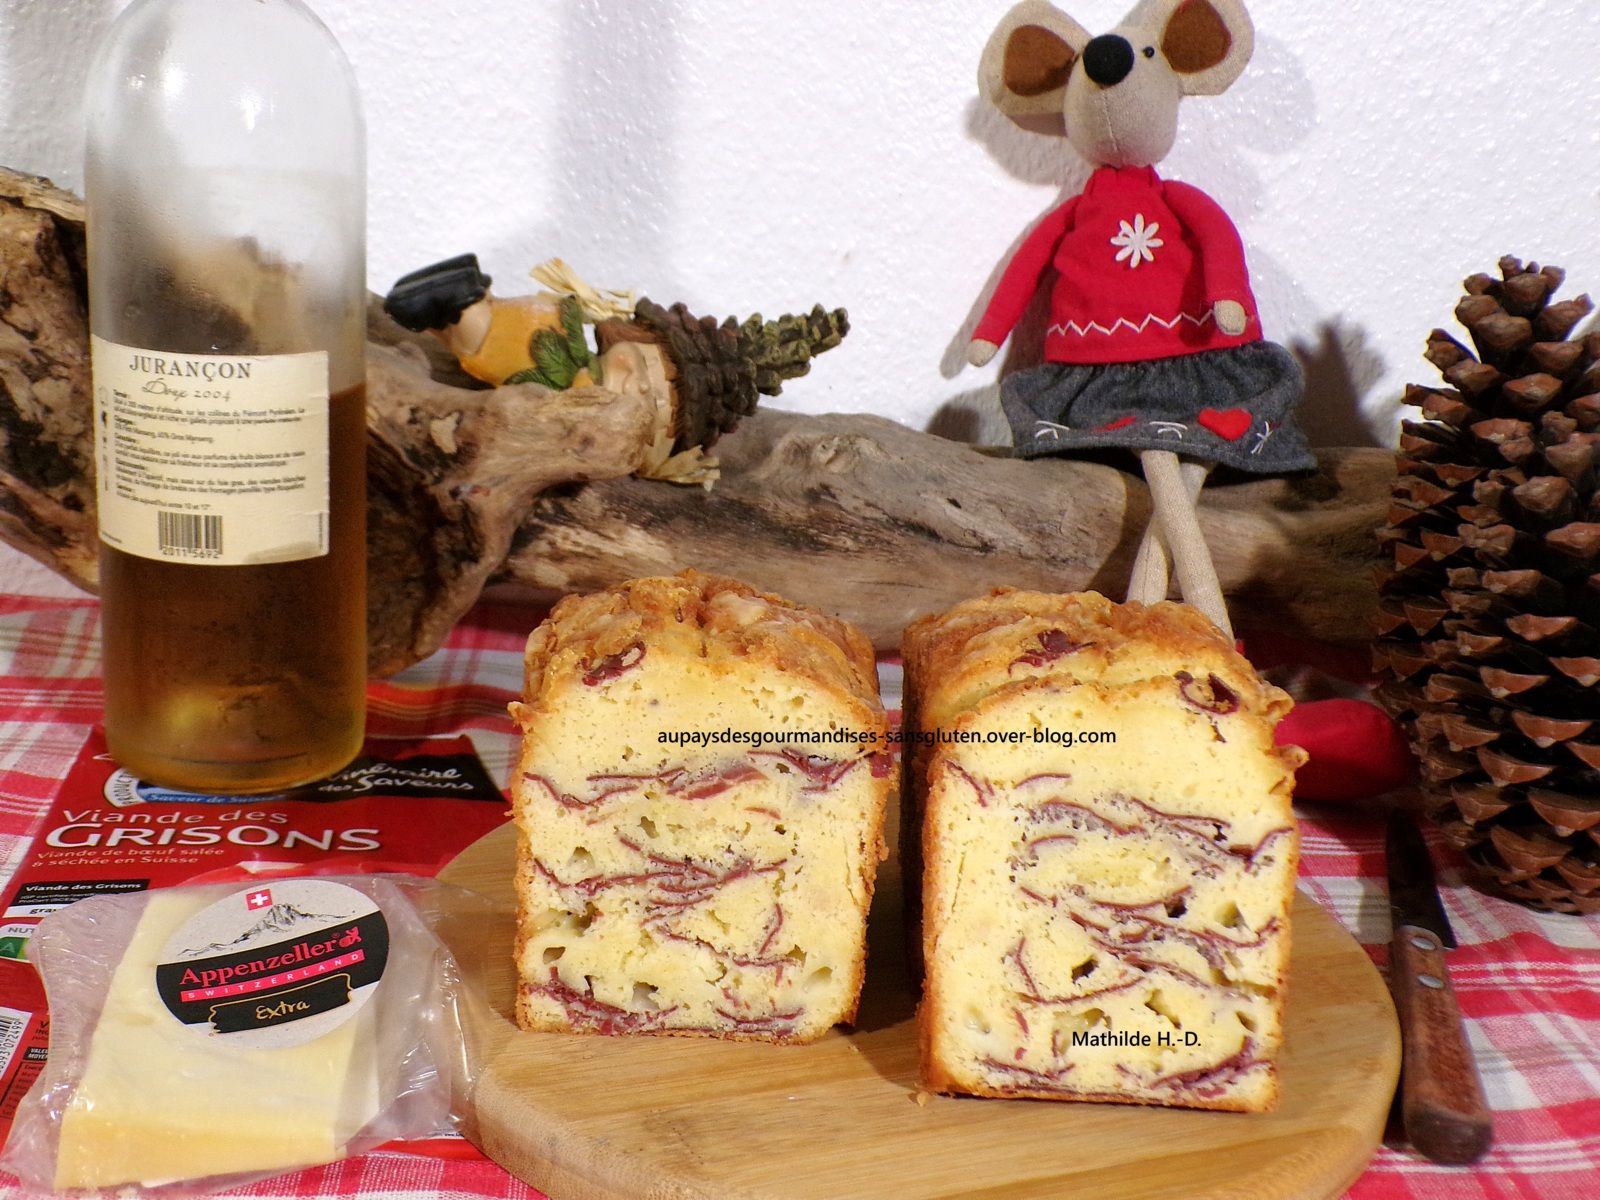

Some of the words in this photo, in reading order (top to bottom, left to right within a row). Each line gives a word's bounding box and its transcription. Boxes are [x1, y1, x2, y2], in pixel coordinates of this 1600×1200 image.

[129, 355, 252, 382] JURANÇON
[63, 808, 205, 825] Viande
[217, 808, 289, 825] des
[45, 822, 381, 851] GRISONS
[37, 849, 97, 859] Viande
[102, 848, 123, 857] de
[180, 847, 225, 857] salée
[48, 857, 106, 867] séchée
[113, 857, 136, 865] en
[139, 855, 199, 865] Suisse
[25, 883, 70, 893] Viande
[71, 883, 93, 891] des
[95, 882, 142, 890] Grisons
[188, 953, 360, 1000] SWITZERLAND
[255, 999, 311, 1020] Extra
